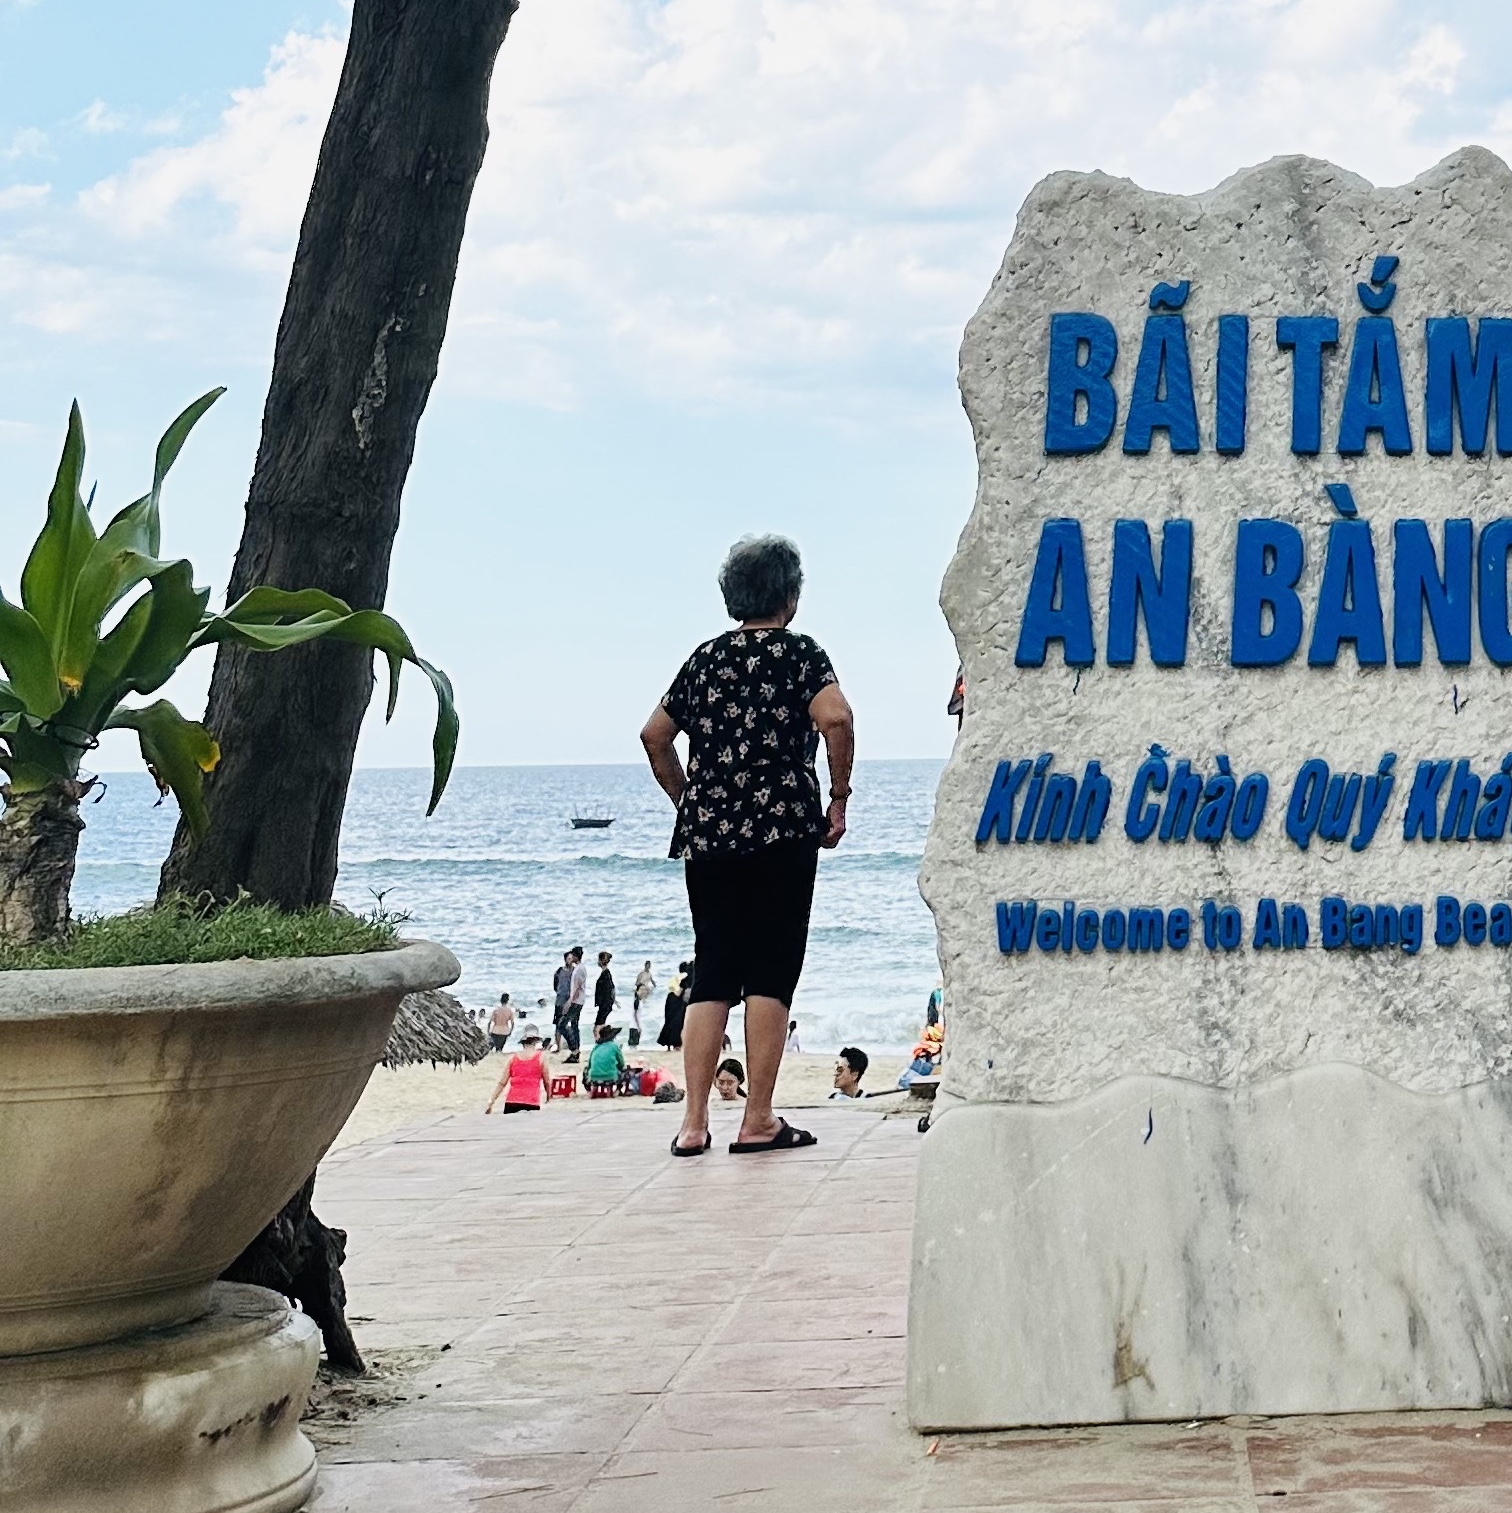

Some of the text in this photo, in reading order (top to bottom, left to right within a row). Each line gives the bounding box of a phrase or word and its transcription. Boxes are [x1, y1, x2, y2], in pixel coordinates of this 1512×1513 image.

[1043, 279, 1248, 456] BÃI
[1014, 517, 1194, 668] AN
[974, 752, 1112, 844] Kính
[1124, 743, 1270, 844] Chào
[1285, 752, 1397, 852] Quý
[995, 900, 1192, 953] Welcome
[1201, 899, 1243, 951] to
[1252, 898, 1310, 951] An
[1319, 896, 1424, 954] Bang
